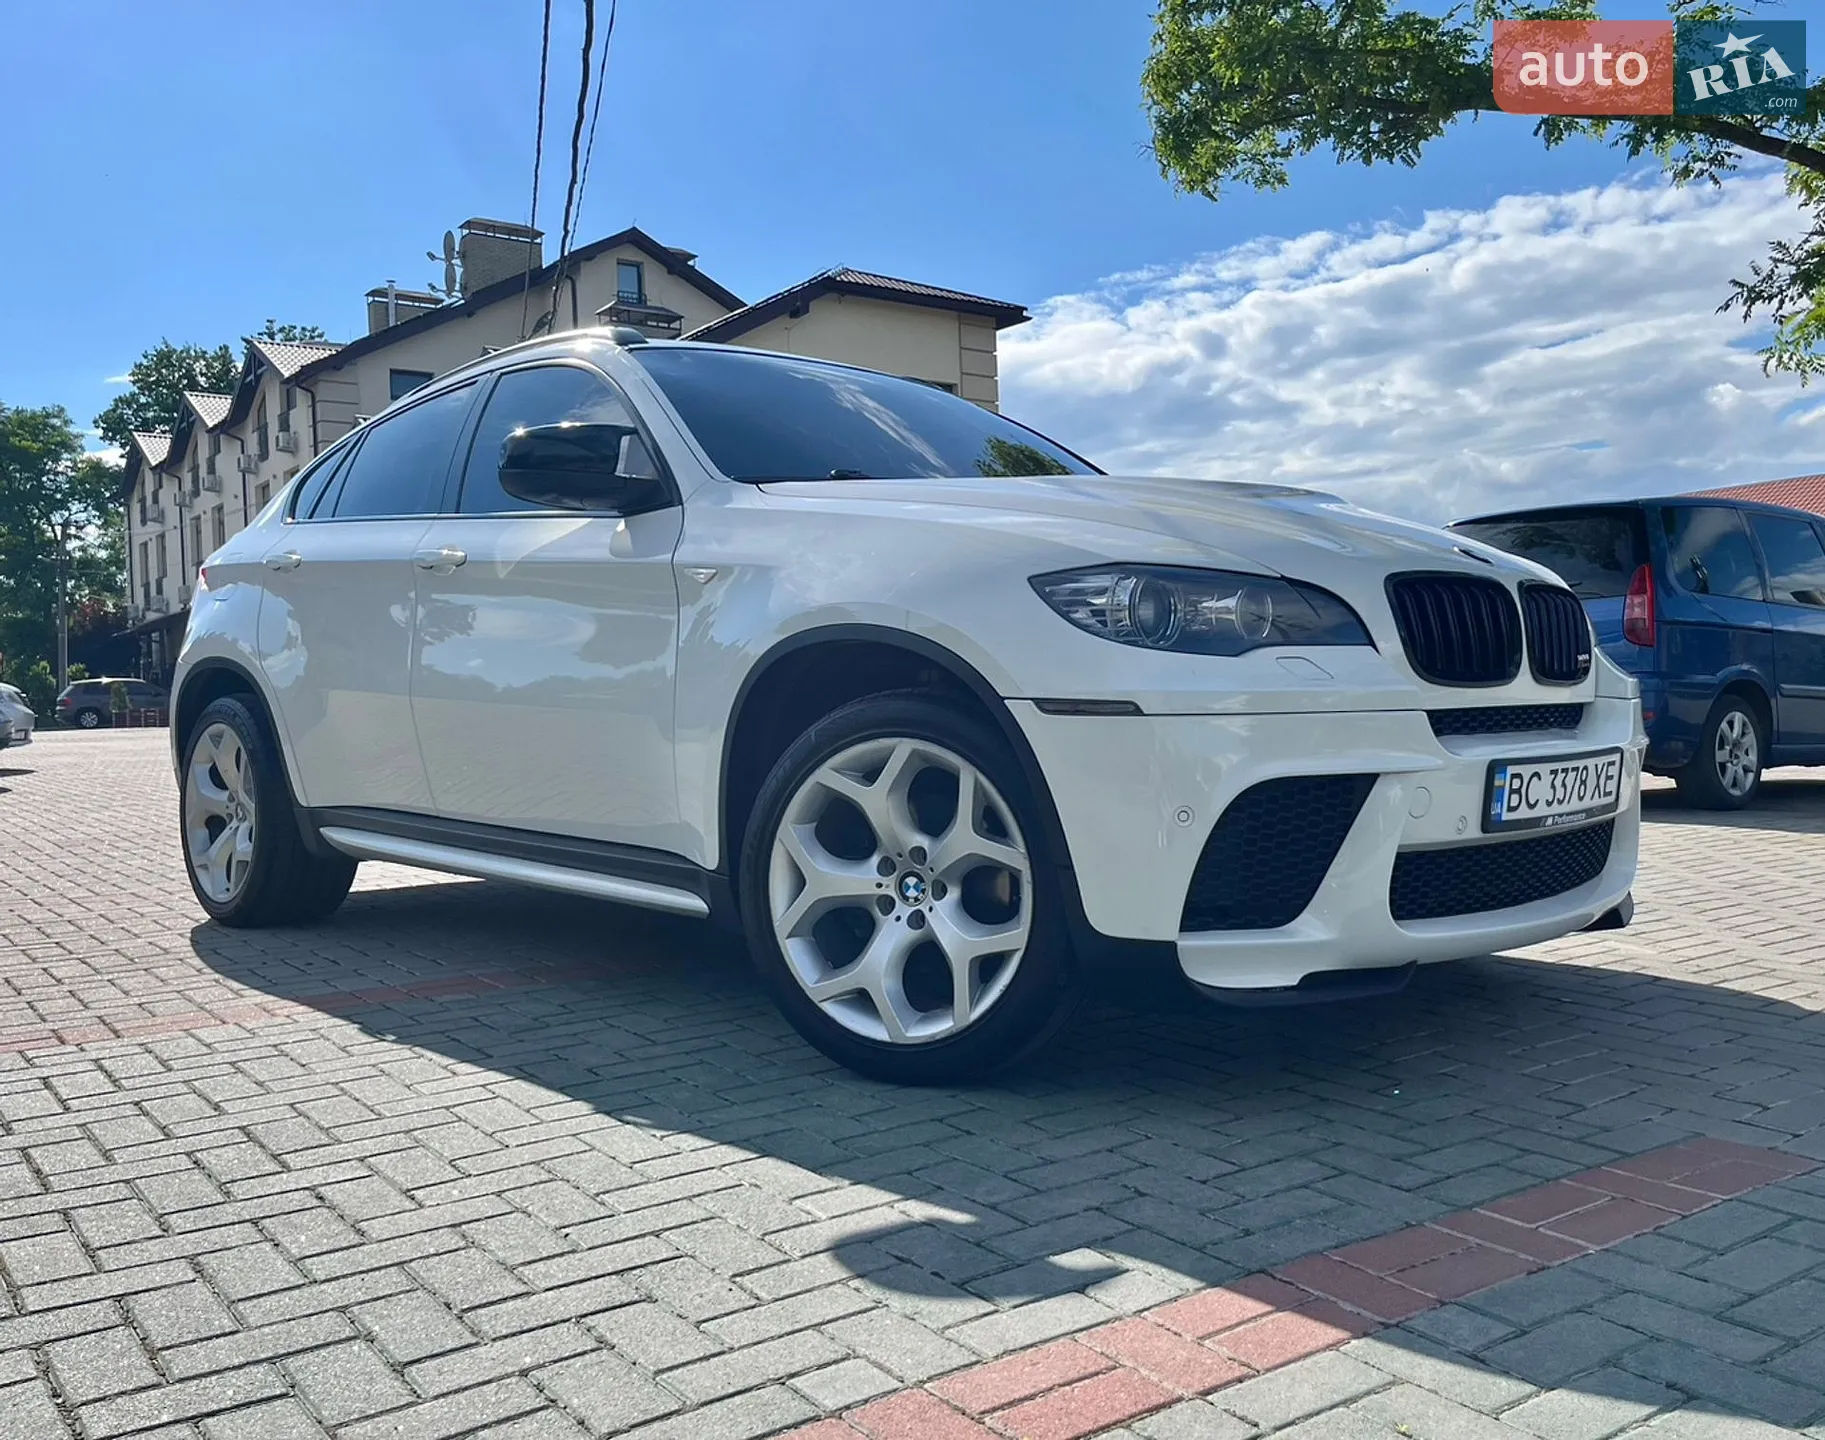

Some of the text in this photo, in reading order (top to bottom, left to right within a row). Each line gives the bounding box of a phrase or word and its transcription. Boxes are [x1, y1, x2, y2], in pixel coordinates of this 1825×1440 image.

[1507, 760, 1616, 812] BC 3378 XE
